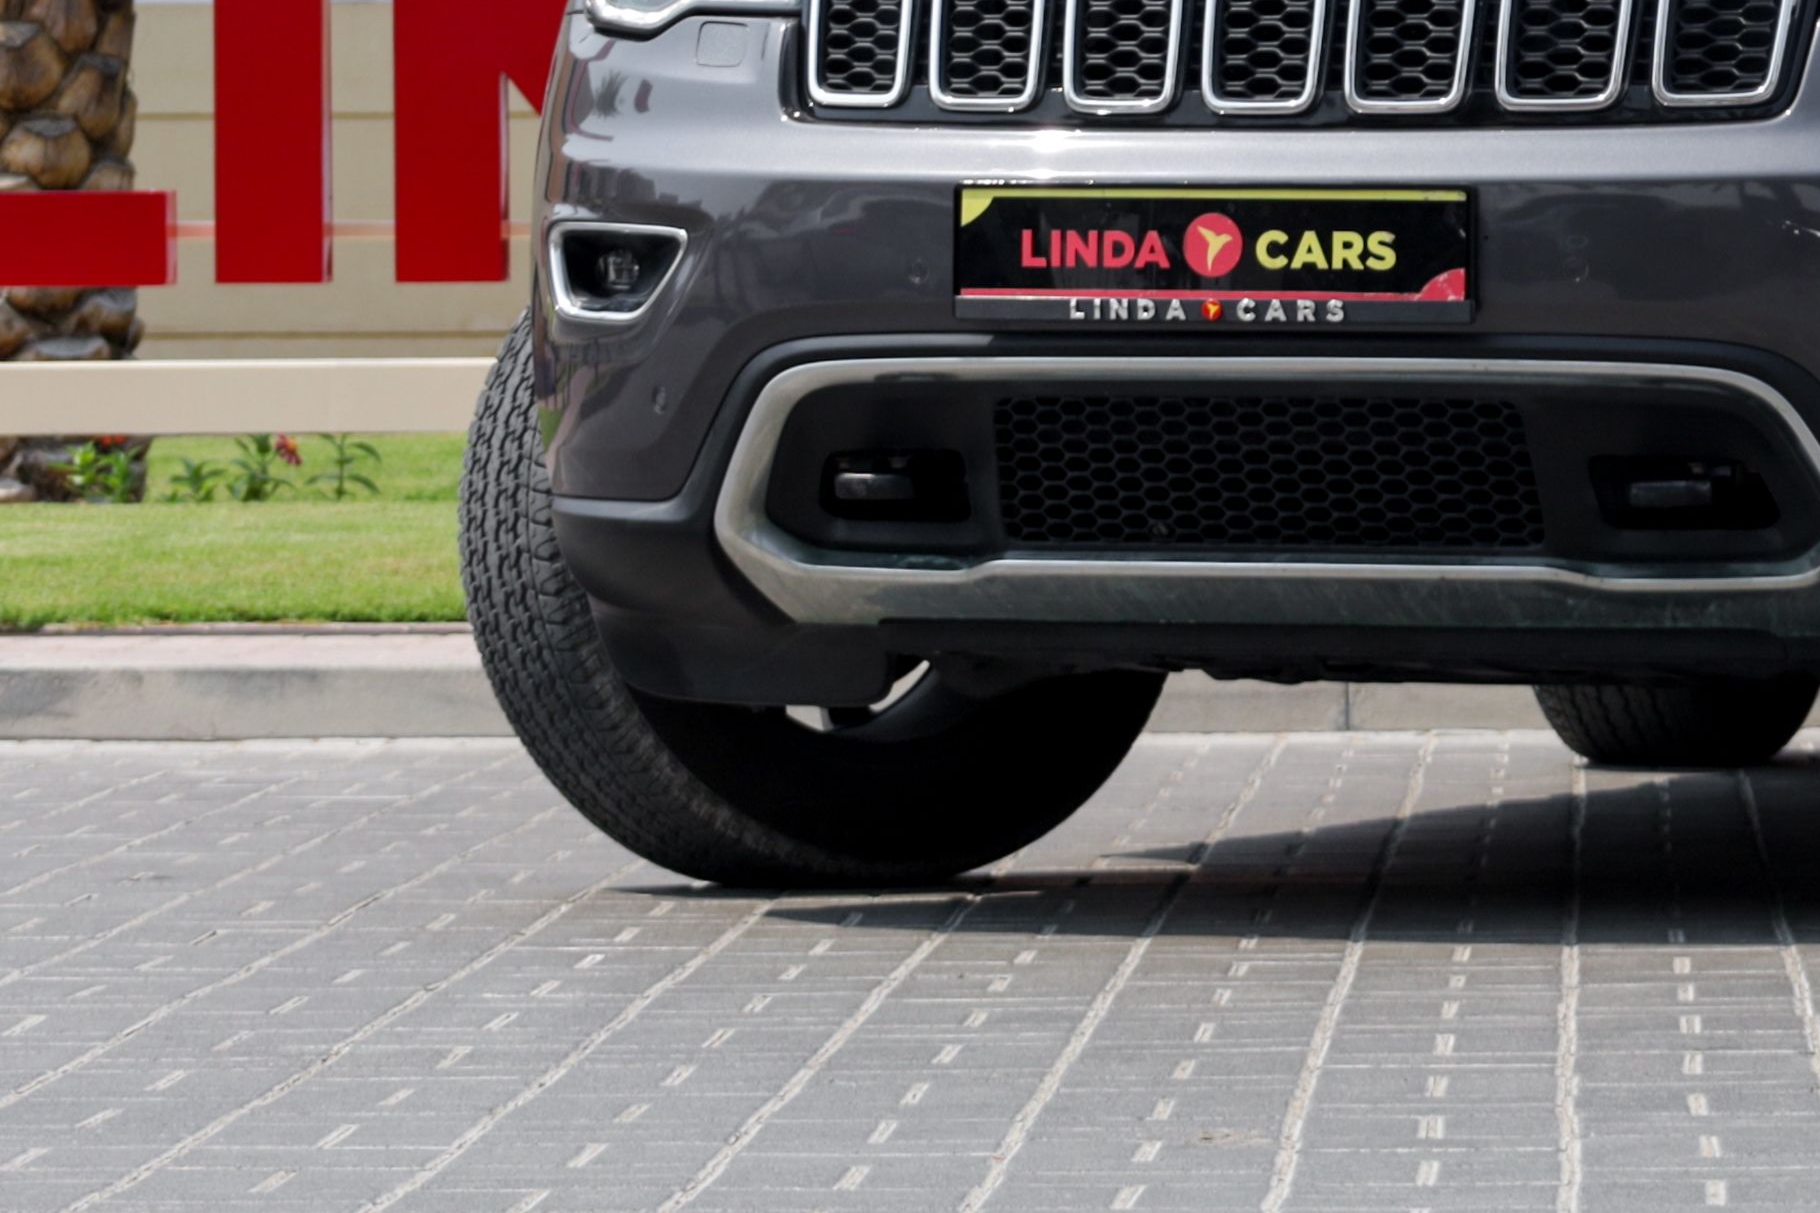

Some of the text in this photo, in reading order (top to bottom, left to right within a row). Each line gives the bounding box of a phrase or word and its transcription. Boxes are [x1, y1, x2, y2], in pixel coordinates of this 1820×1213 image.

[1020, 229, 1397, 271] LINDA CARS
[1069, 297, 1345, 322] LINDA CARS
